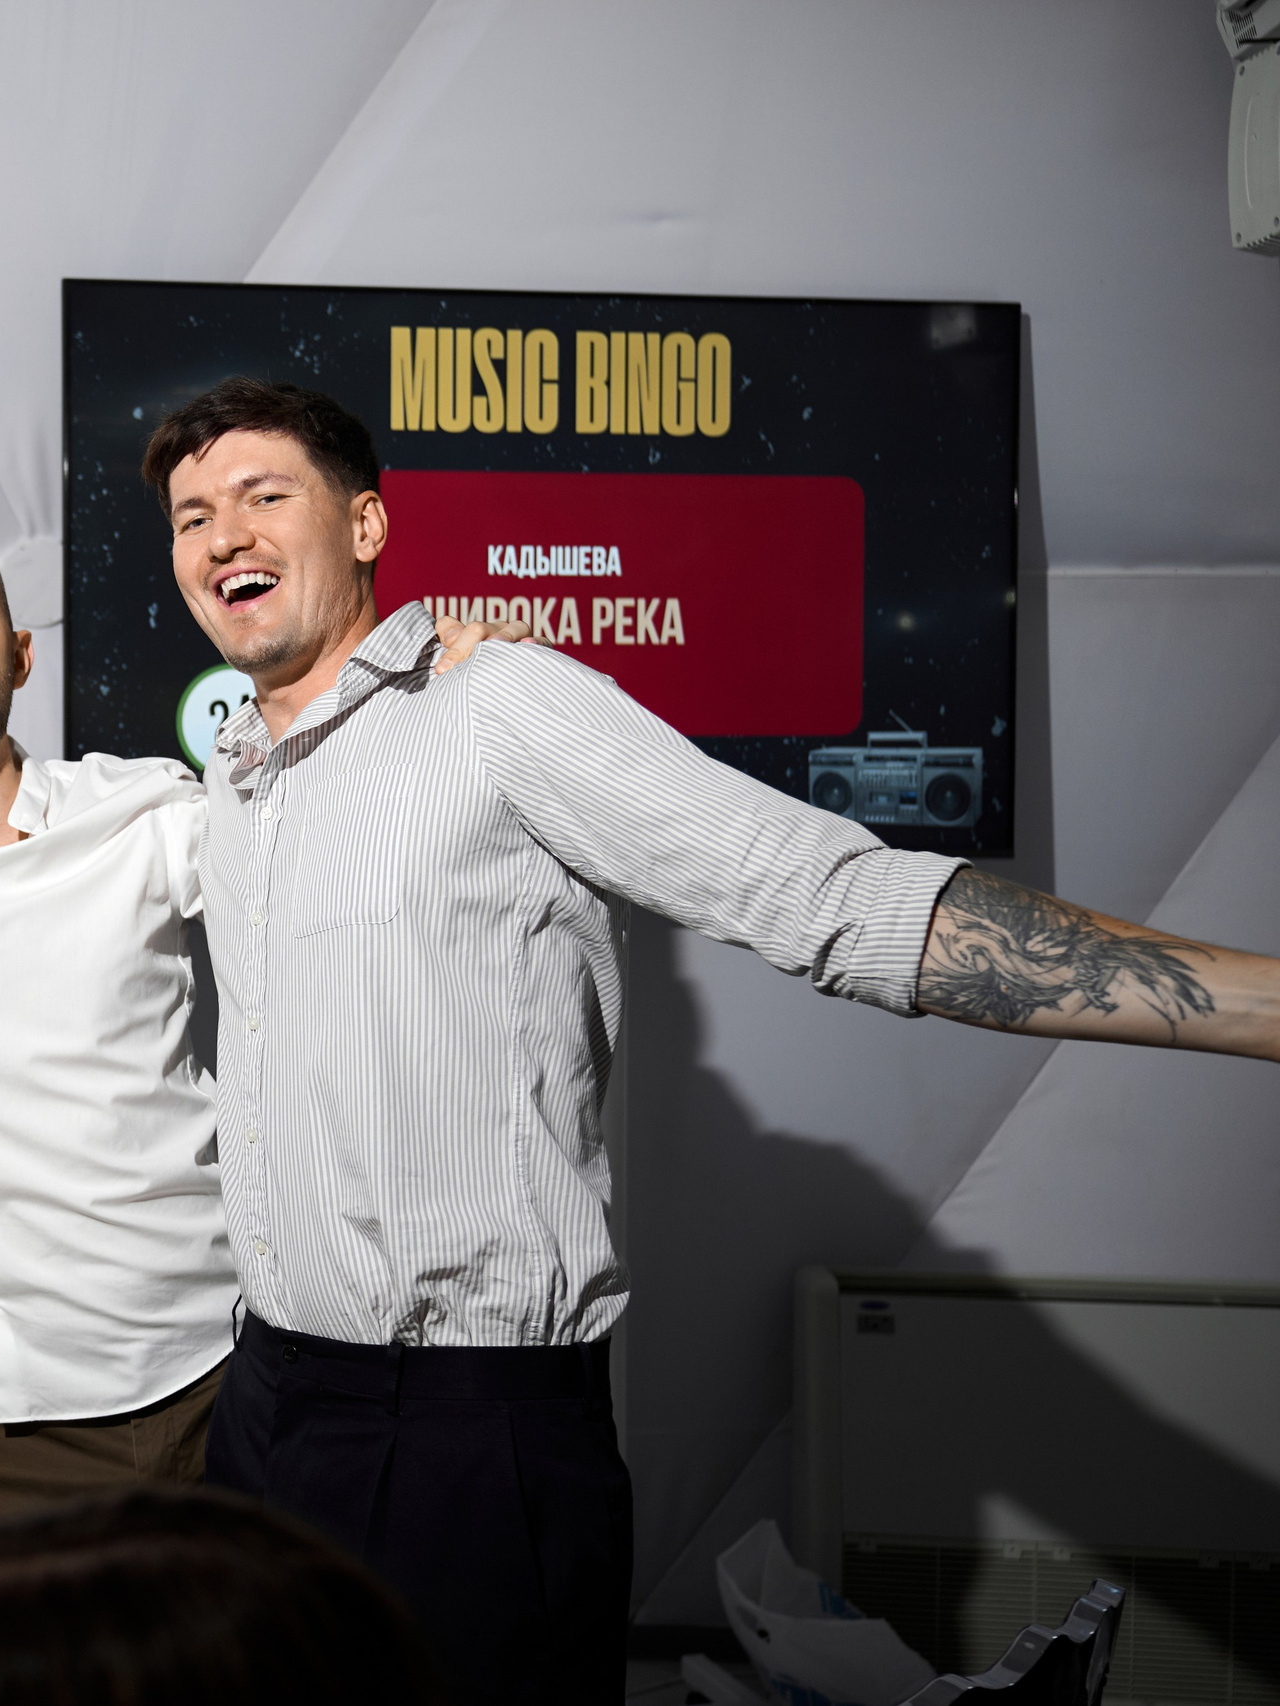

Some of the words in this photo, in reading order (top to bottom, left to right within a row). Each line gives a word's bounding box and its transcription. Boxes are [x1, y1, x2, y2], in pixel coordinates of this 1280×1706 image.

[390, 326, 559, 434] MUSIC
[575, 330, 732, 437] BINGO
[487, 545, 622, 579] КАДЫШЕВА
[592, 598, 685, 645] РЕКА
[209, 694, 250, 726] 2
